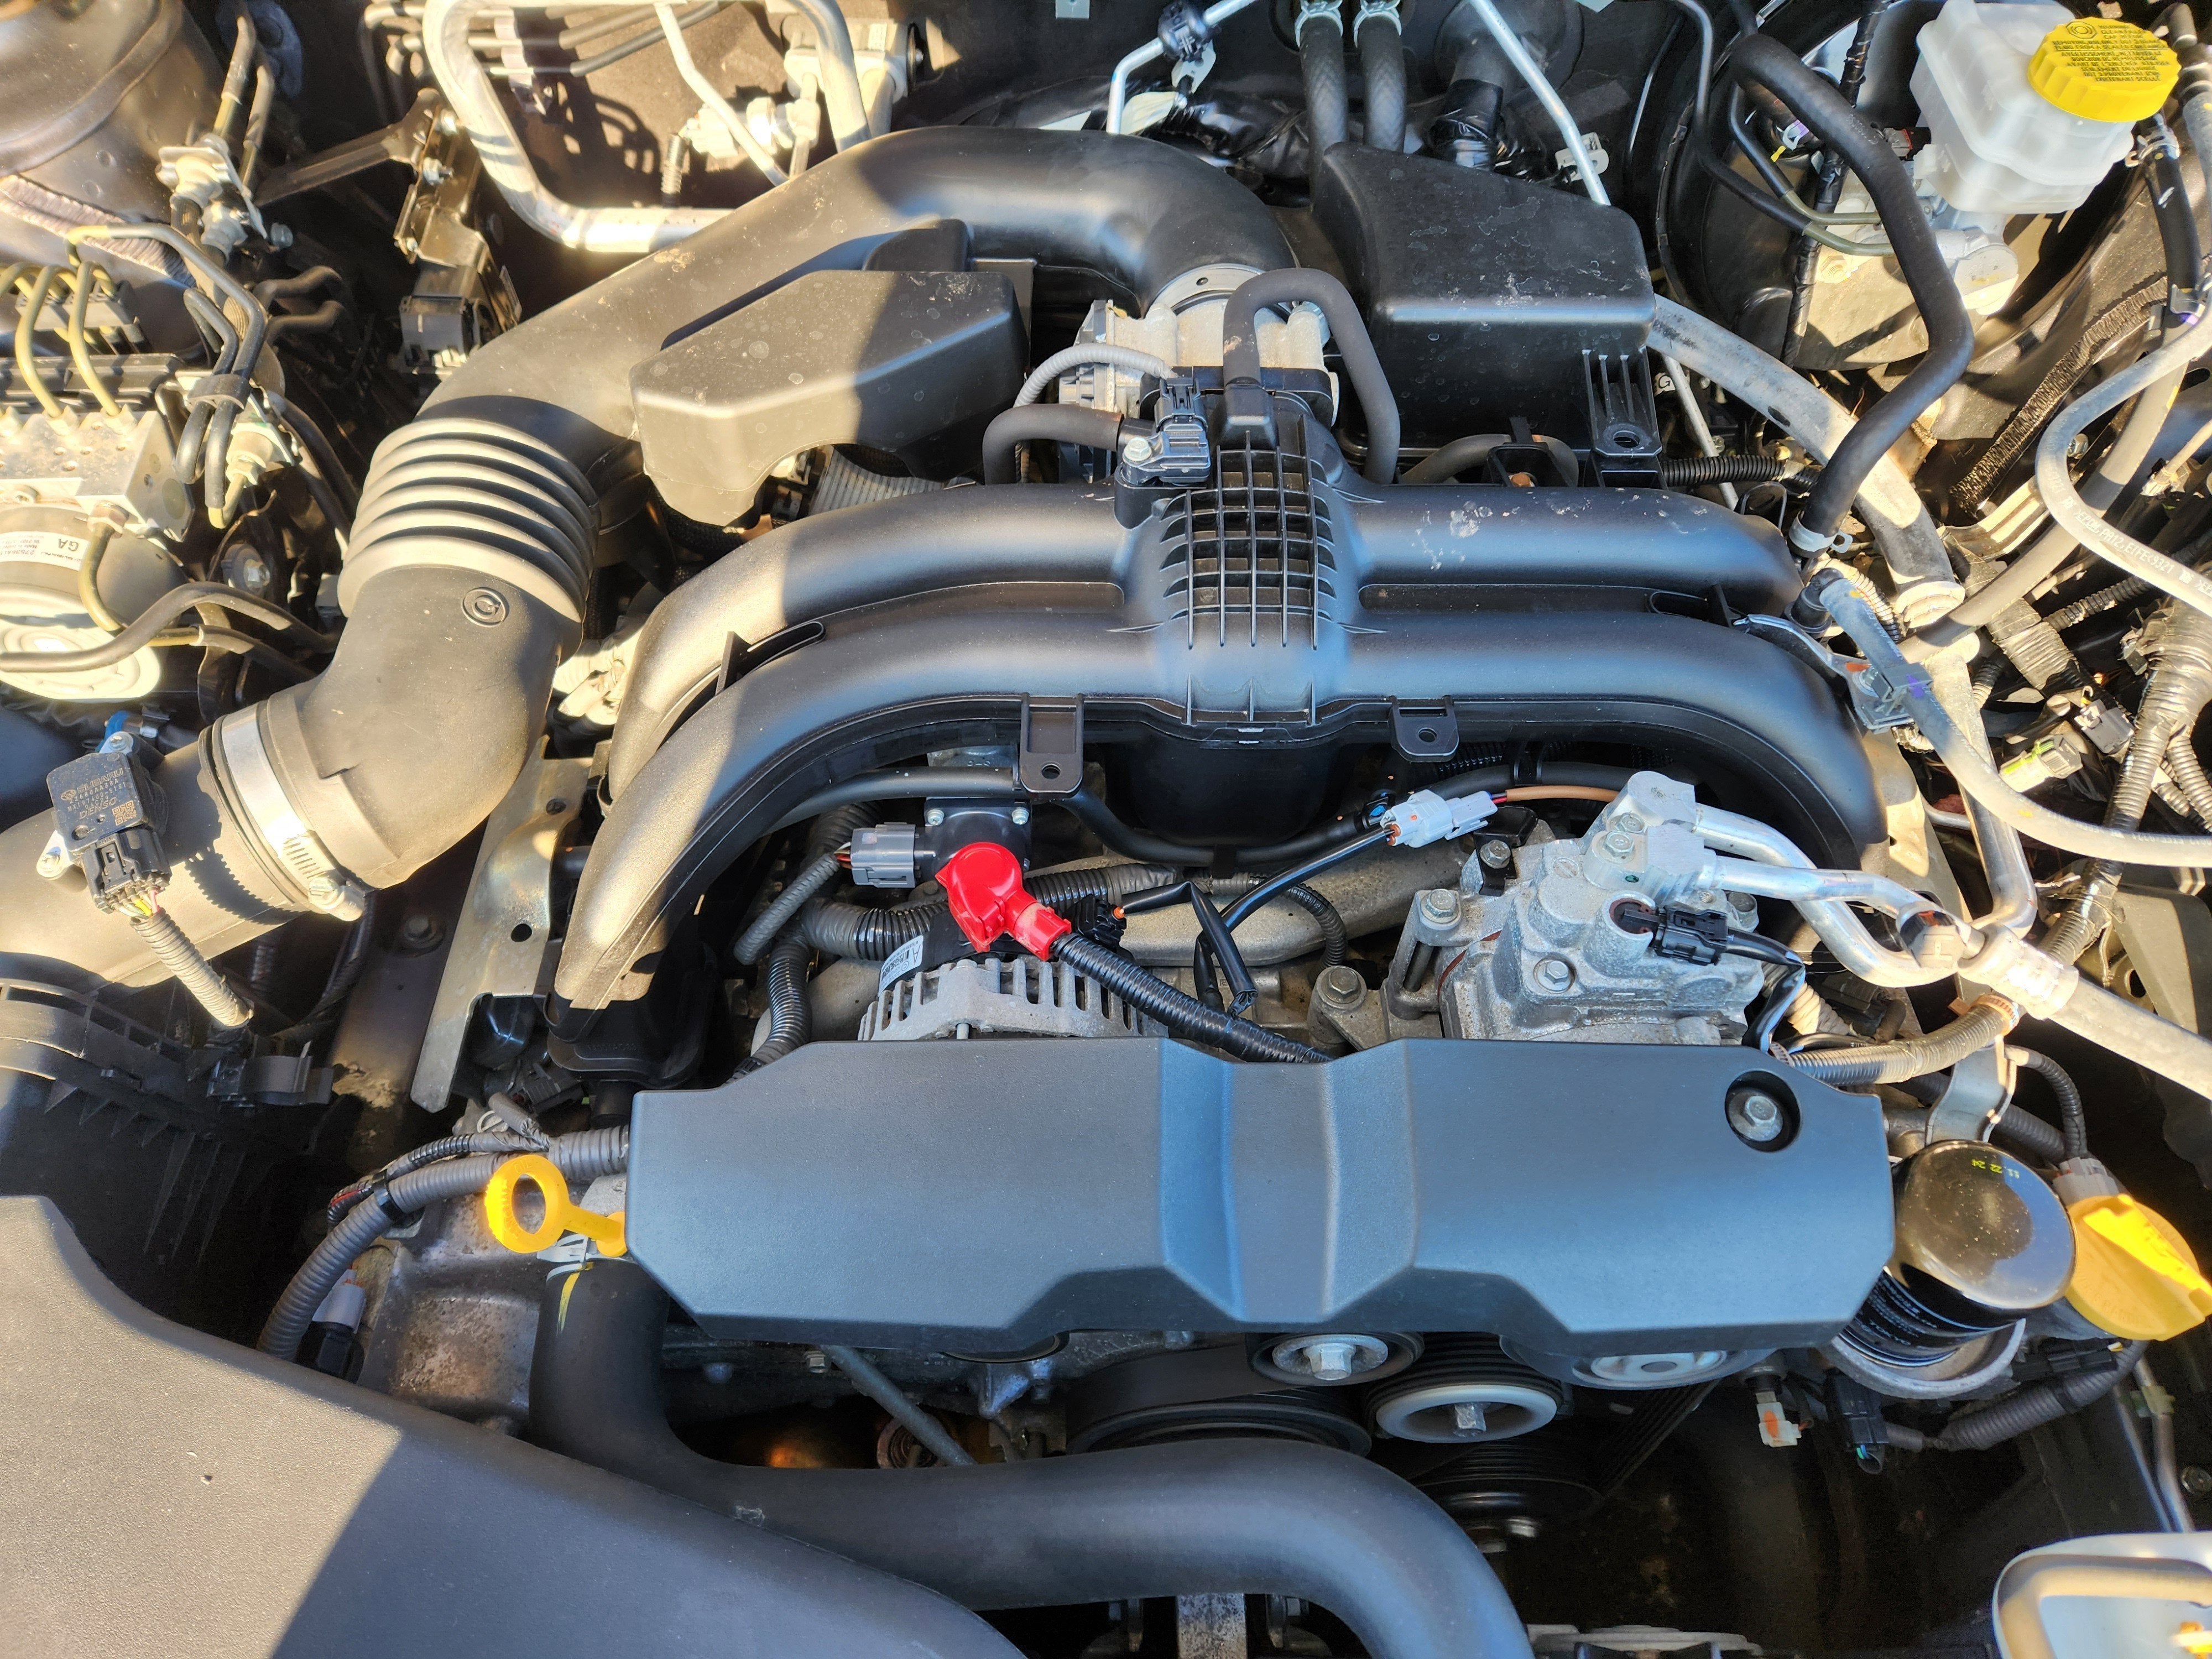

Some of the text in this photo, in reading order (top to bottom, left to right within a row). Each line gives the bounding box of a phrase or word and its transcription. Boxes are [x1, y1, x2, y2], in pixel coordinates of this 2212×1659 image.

[58, 538, 80, 552] GA
[77, 768, 124, 793] SUBARU
[79, 796, 117, 820] DENSO
